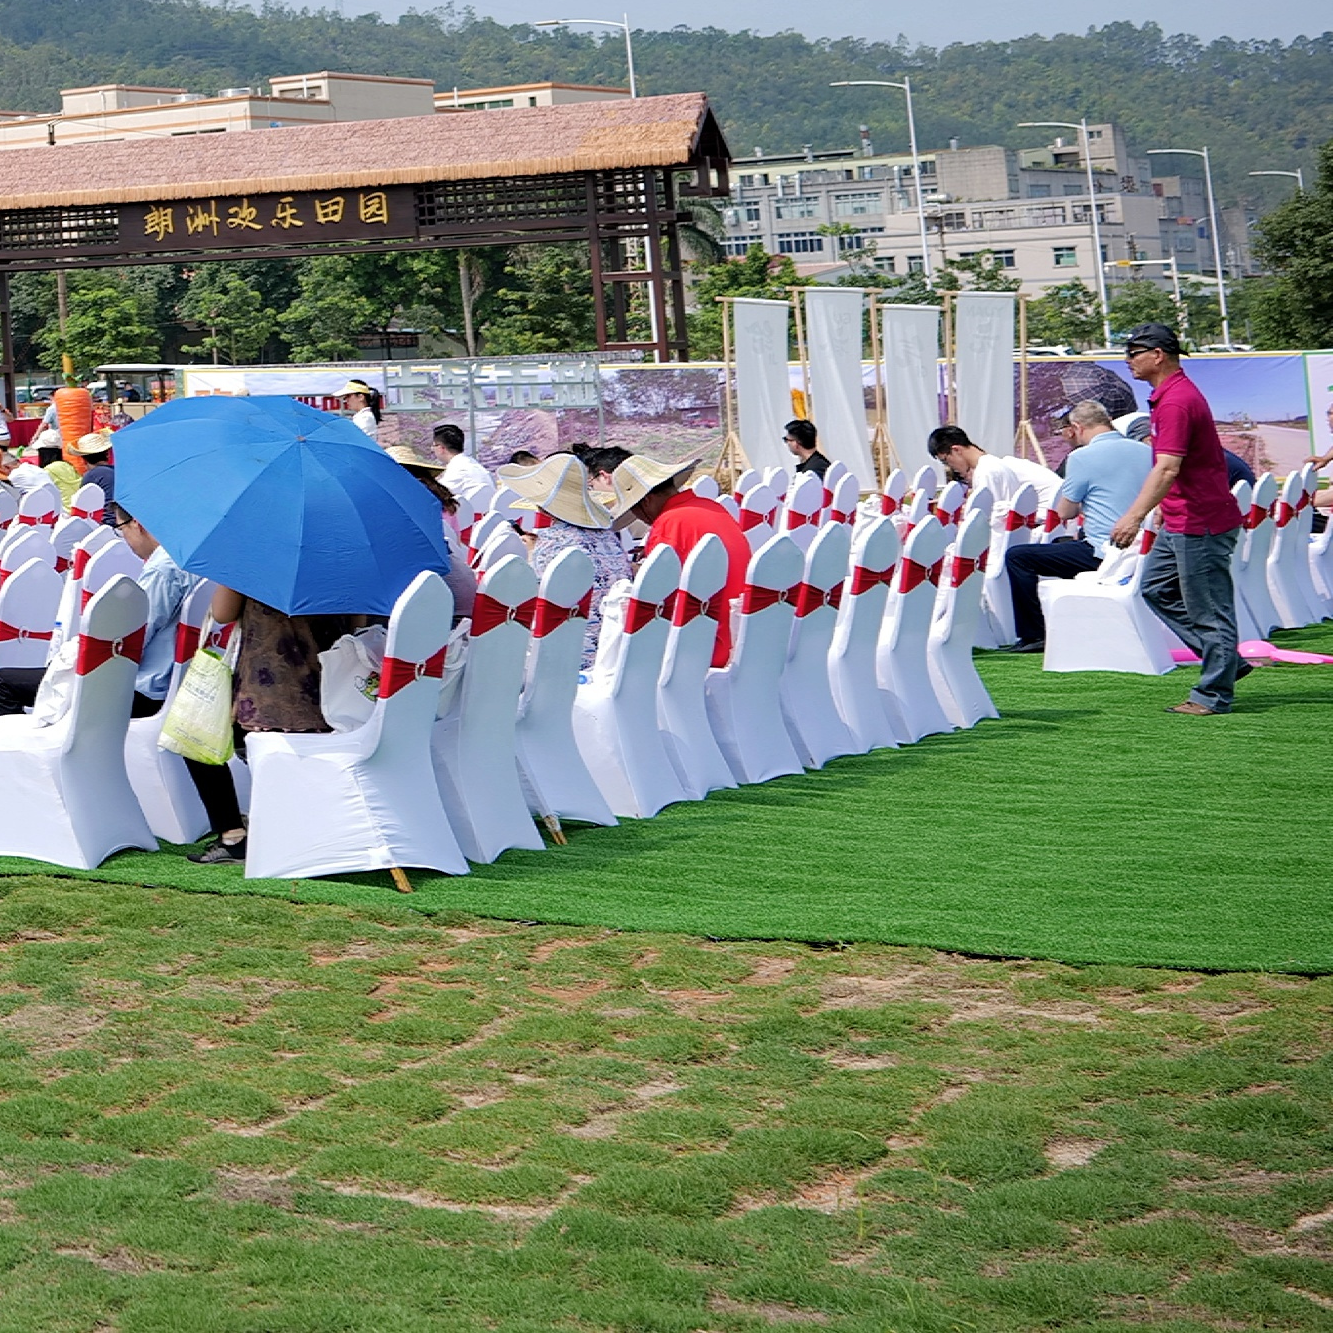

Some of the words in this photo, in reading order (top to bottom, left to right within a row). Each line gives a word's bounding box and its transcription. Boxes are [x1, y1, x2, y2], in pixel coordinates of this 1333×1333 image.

[143, 192, 388, 242] 朗洲欢乐田园
